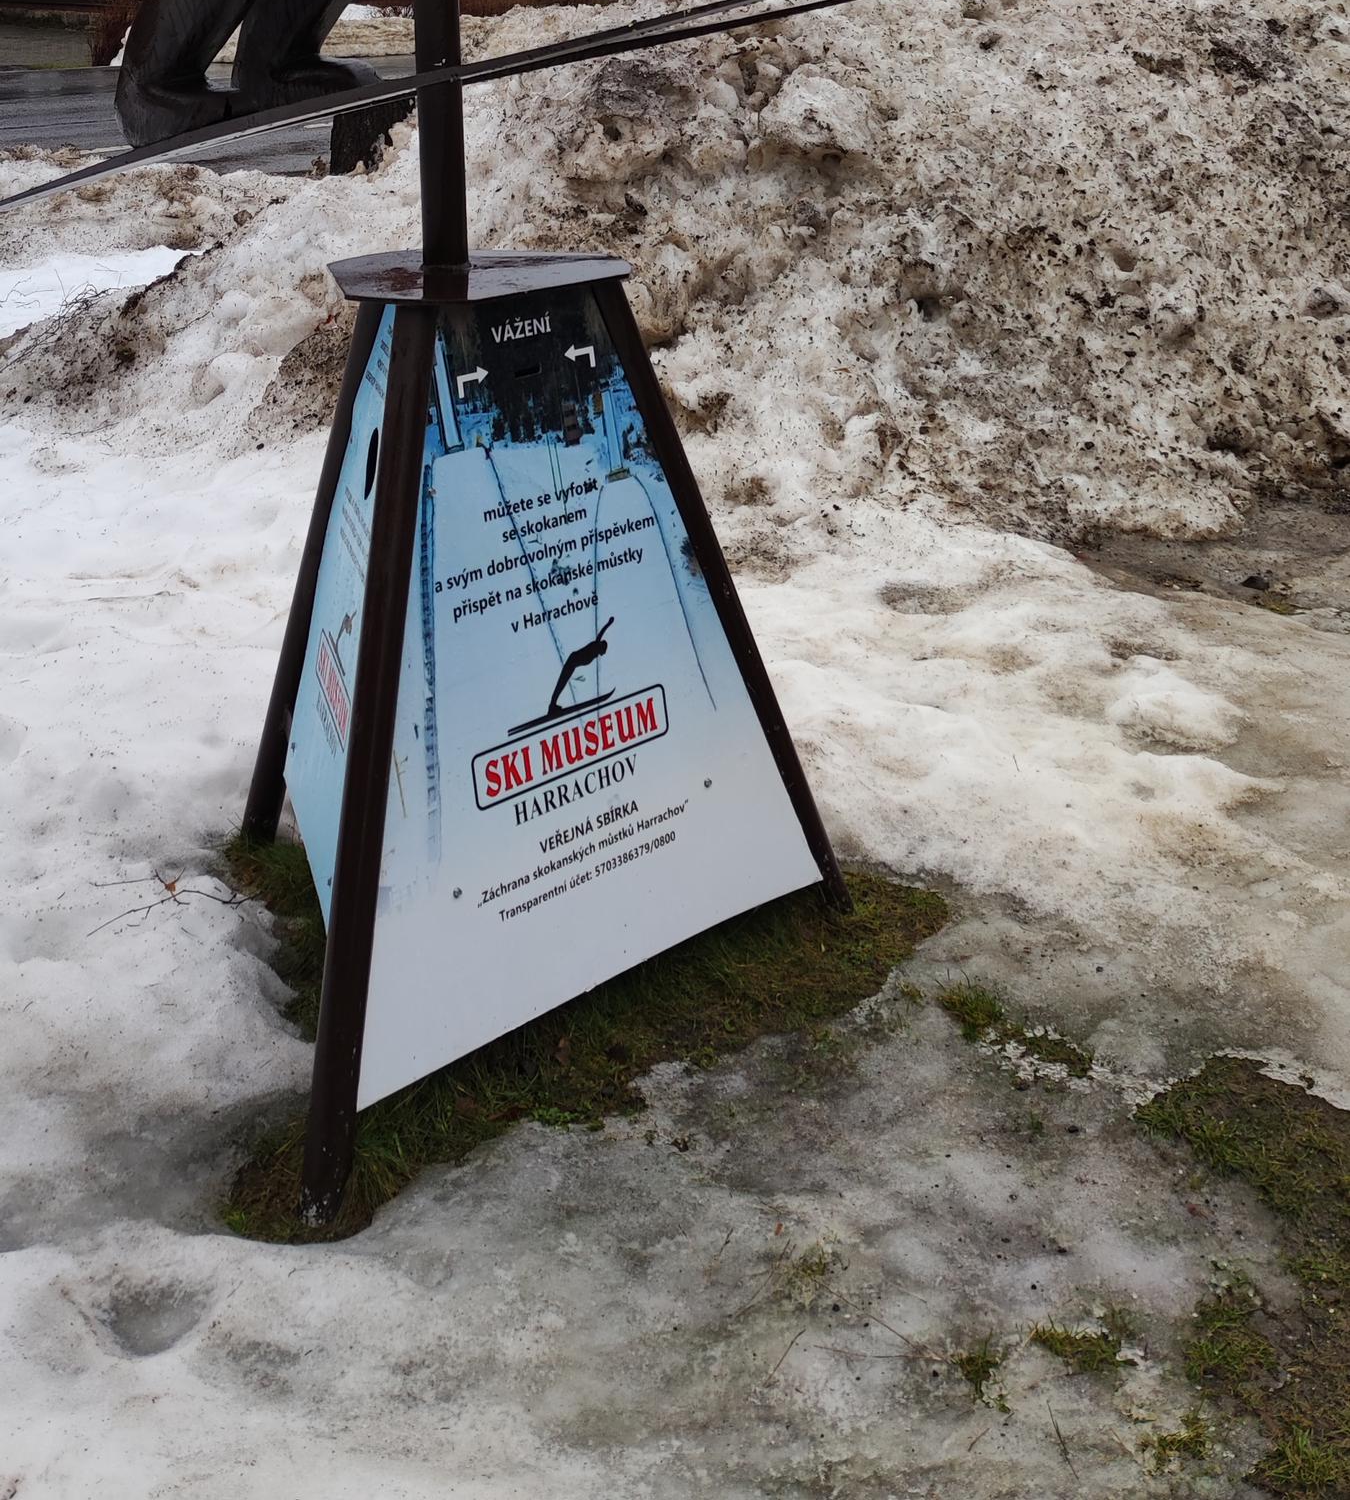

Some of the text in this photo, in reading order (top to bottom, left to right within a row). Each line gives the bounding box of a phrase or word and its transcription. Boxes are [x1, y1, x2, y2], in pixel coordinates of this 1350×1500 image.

[491, 311, 552, 344] VÁŽENÍ
[483, 477, 599, 523] můžete se vyfotit
[502, 508, 588, 543] se skokanem
[435, 515, 655, 594] a svým dobrovolným příspěvkem
[453, 547, 643, 624] přispět na skokanské můstky
[511, 590, 599, 633] v Harrachově
[485, 697, 658, 798] SKI MUSEUM
[513, 753, 639, 827] HARRACHOV
[533, 841, 596, 881] skokanských
[598, 823, 635, 851] můstků
[539, 799, 639, 854] VEŘEJNÁ SBÍRKA
[498, 830, 676, 922] Transparentní účet: 5703386379/0800
